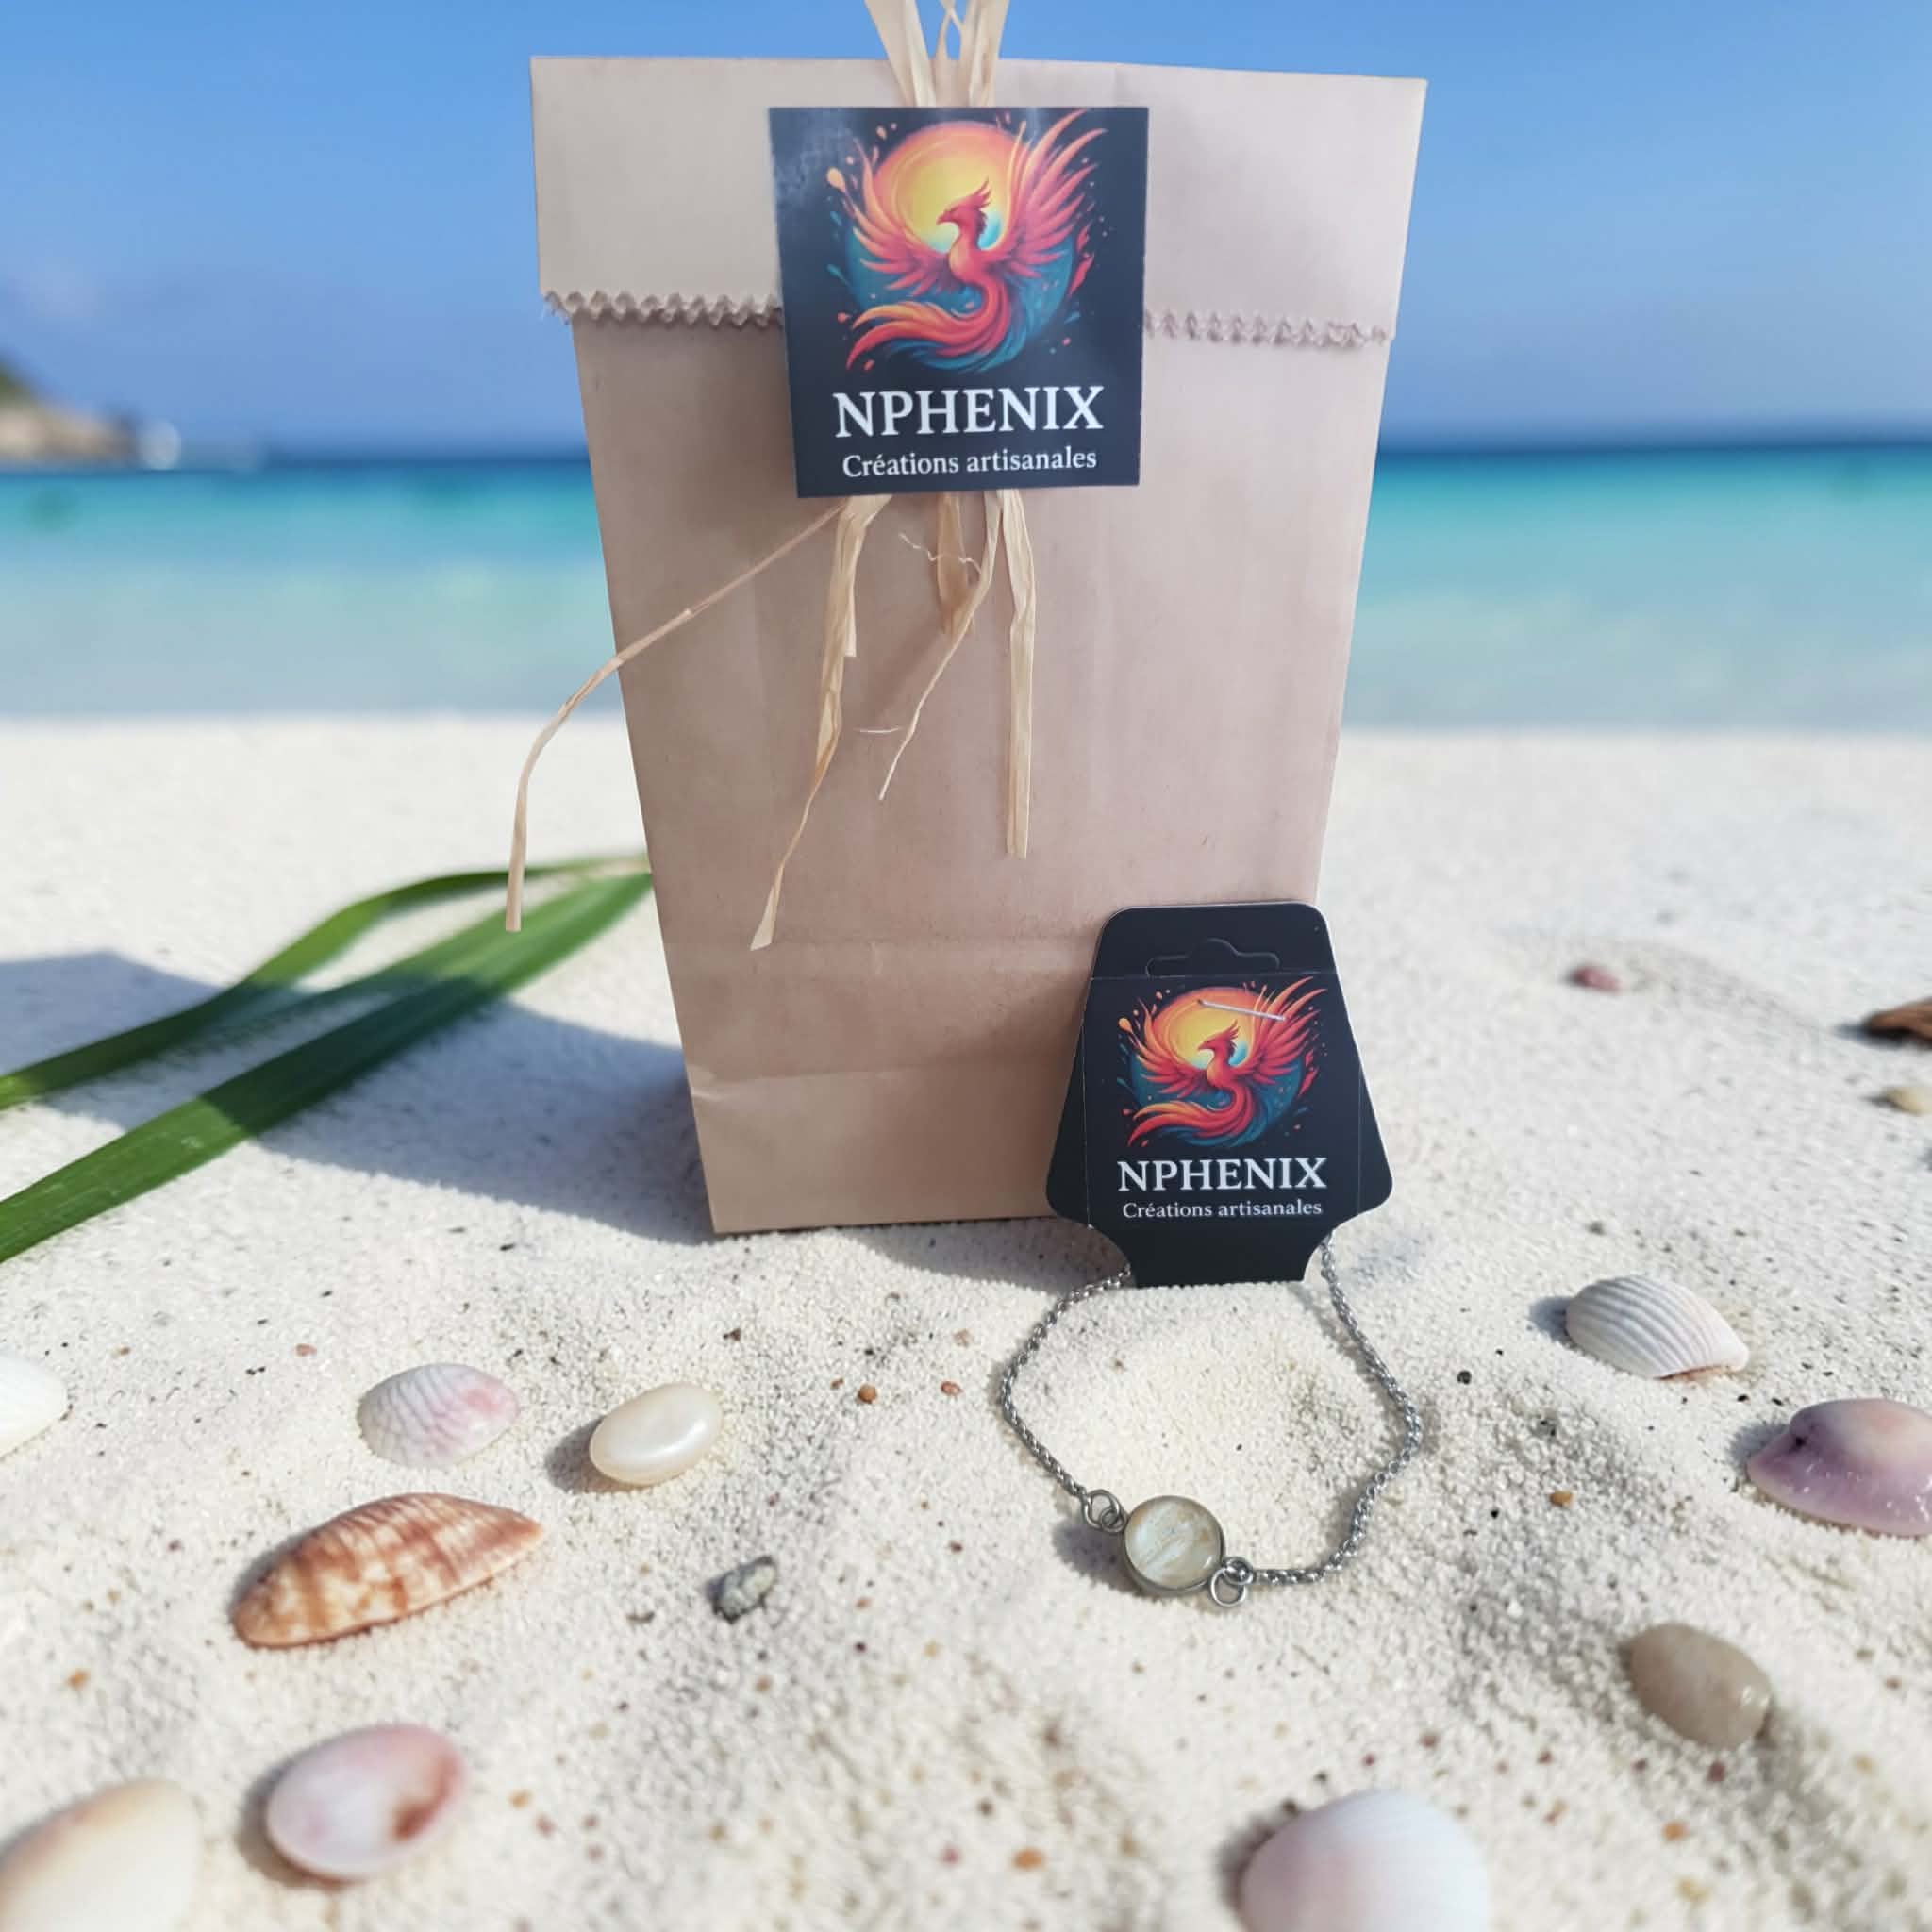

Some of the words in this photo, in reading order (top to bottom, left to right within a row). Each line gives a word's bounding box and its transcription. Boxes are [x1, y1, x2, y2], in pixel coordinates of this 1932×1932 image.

[832, 385, 1105, 439] NPHENIX
[842, 451, 959, 478] Créations
[966, 445, 1097, 473] artisanales
[1117, 1157, 1327, 1191] NPHENIX
[1122, 1201, 1213, 1220] Créations
[1218, 1198, 1323, 1217] artisanales
